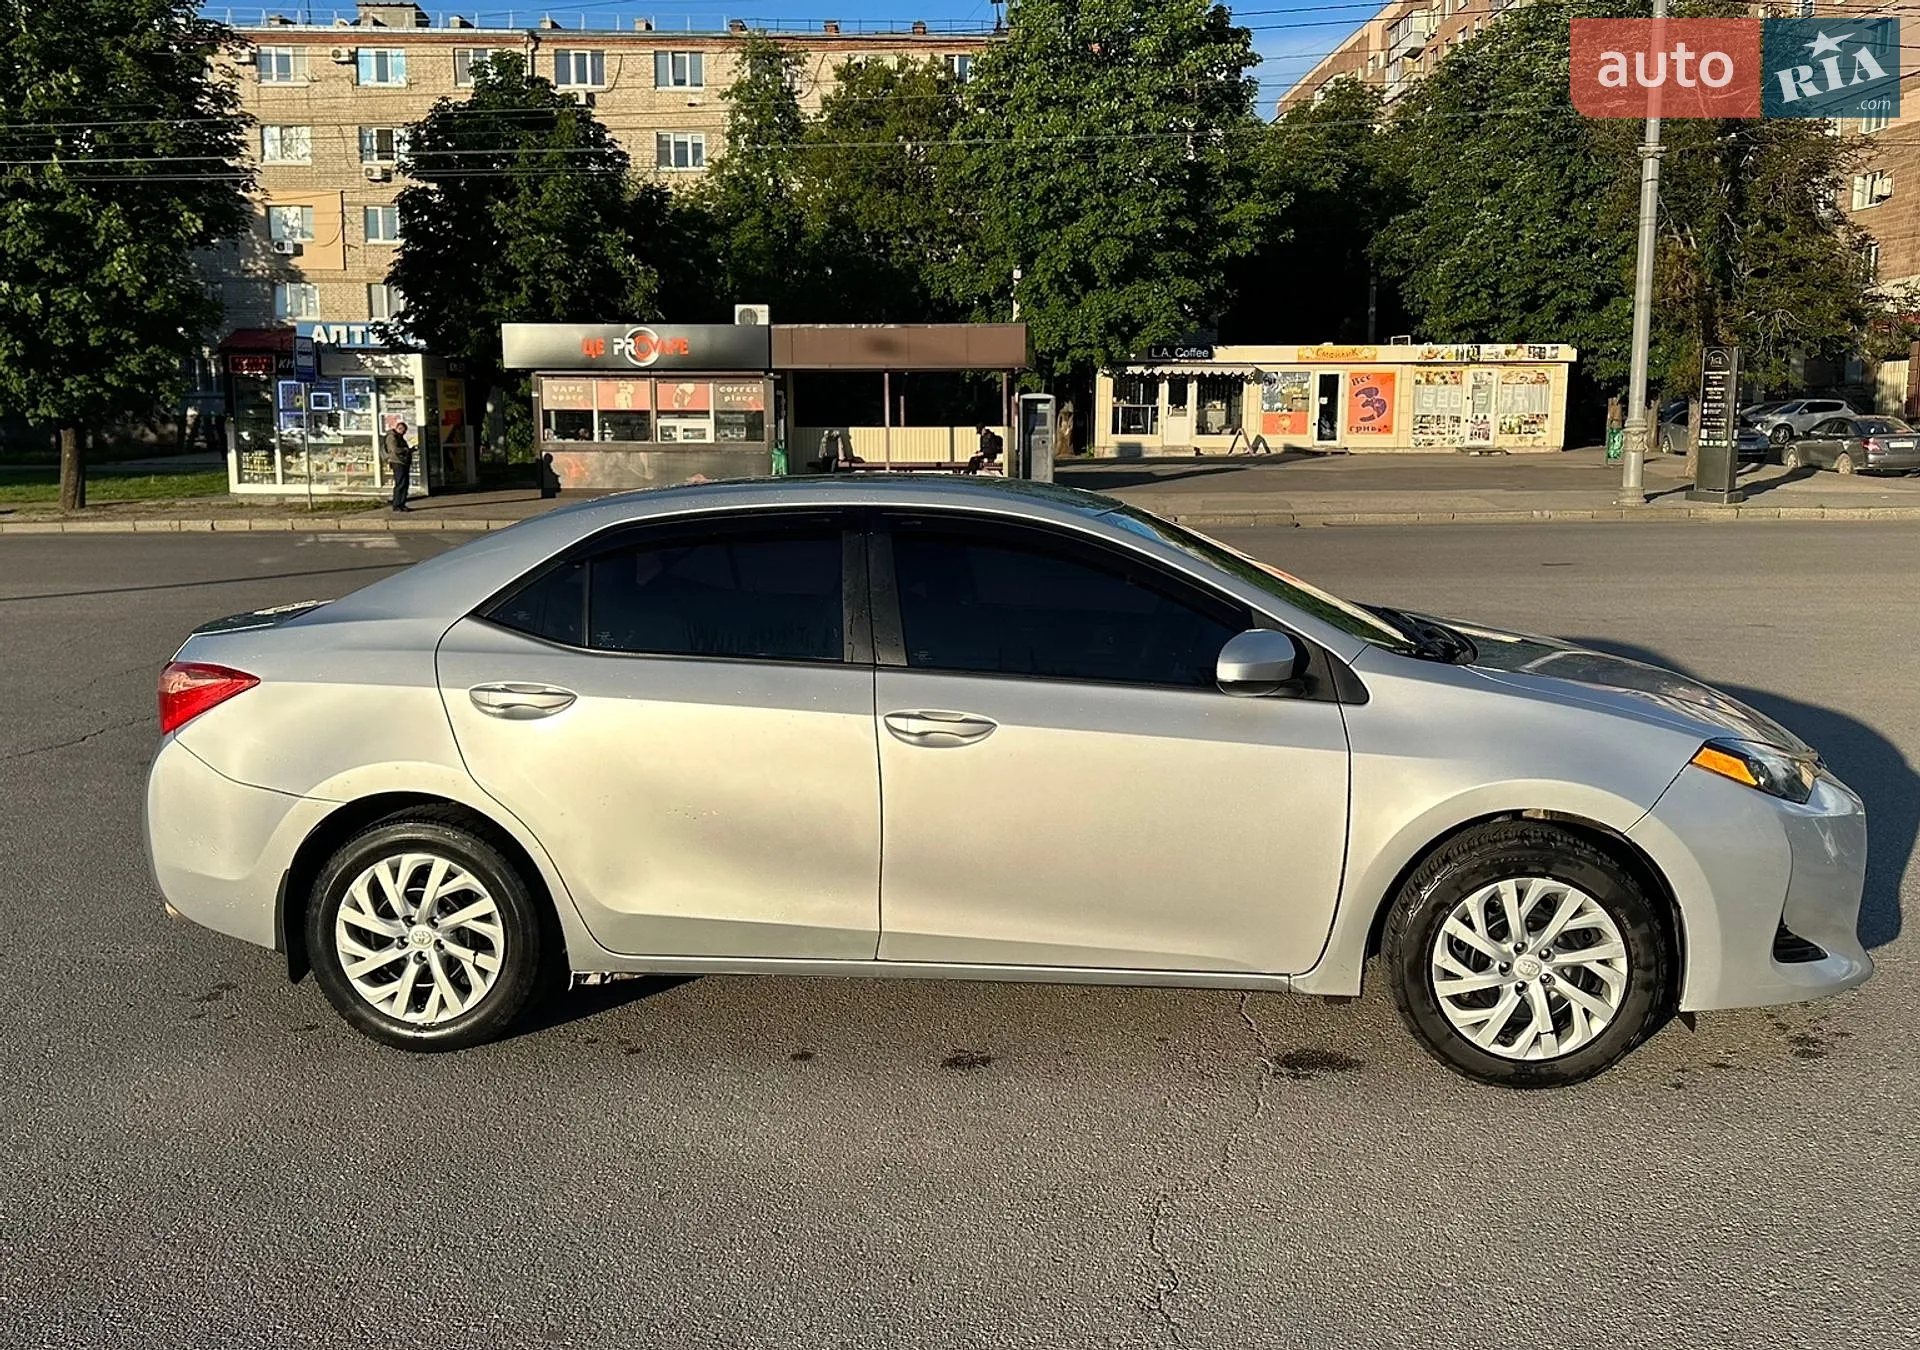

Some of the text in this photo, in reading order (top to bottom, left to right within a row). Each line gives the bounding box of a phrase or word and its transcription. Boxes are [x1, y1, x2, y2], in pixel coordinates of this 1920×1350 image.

[1174, 347, 1209, 358] Coffee
[551, 385, 584, 393] VAPE
[1354, 386, 1387, 423] 3
